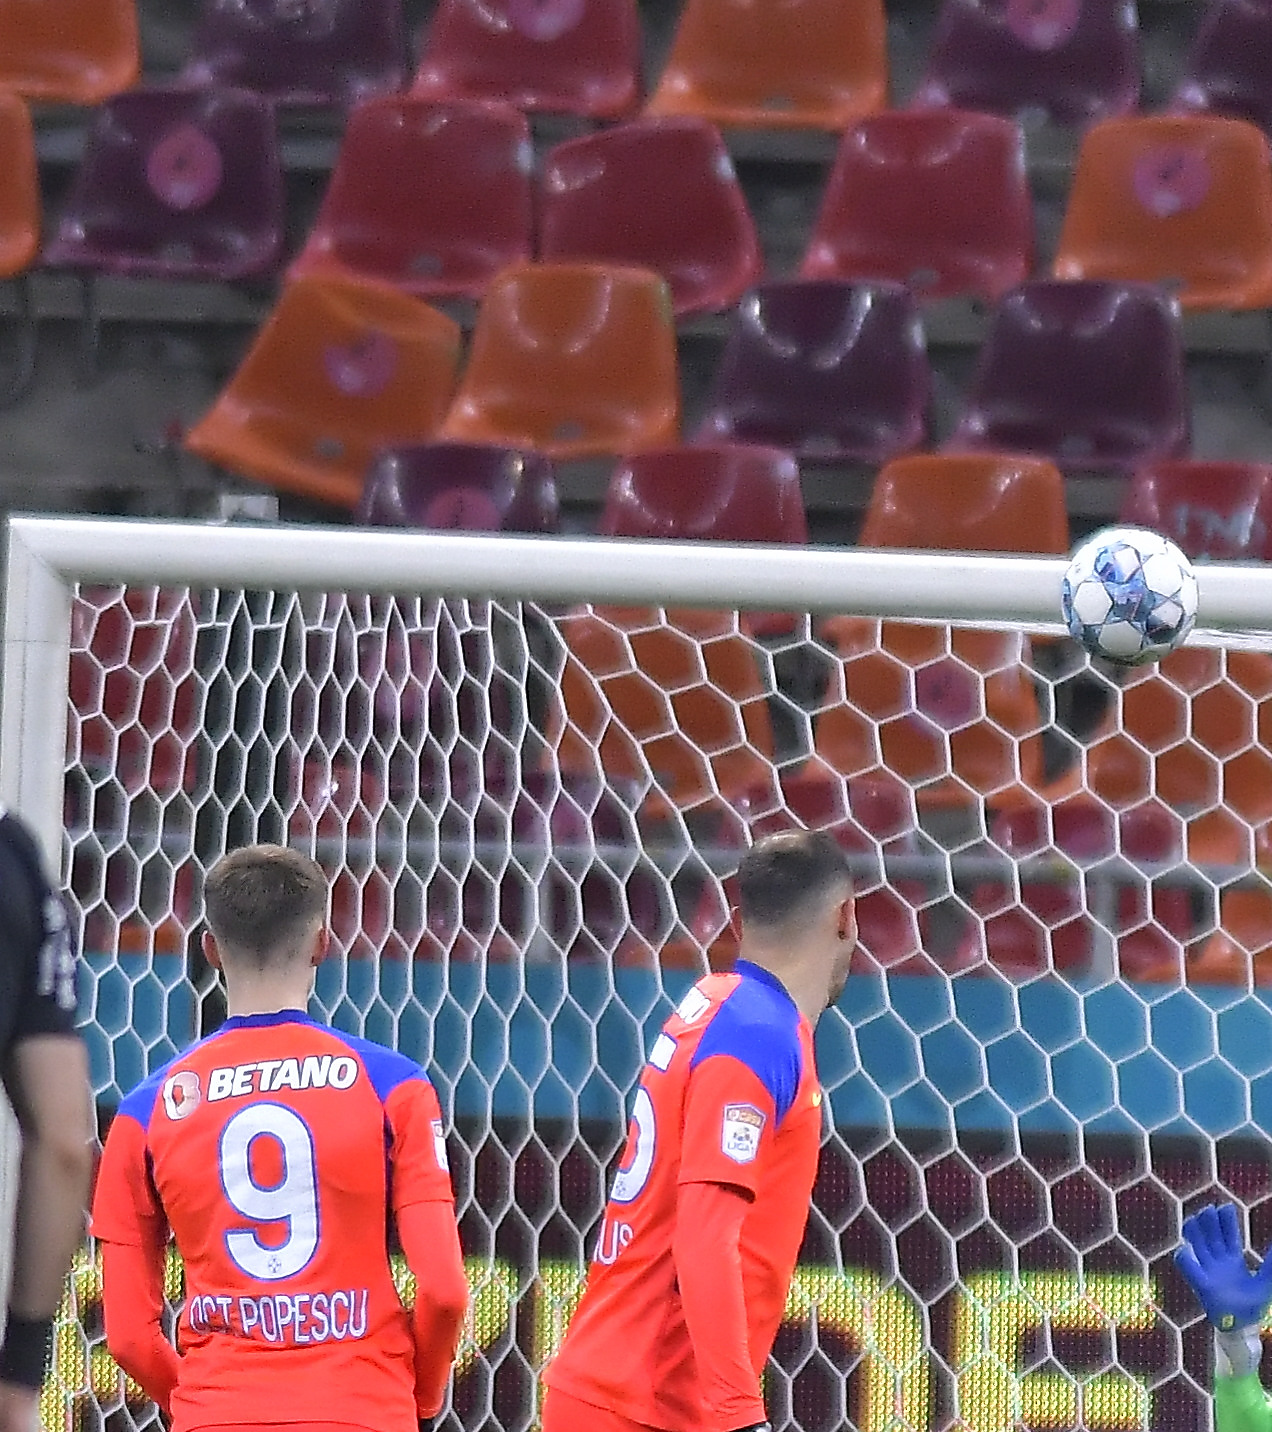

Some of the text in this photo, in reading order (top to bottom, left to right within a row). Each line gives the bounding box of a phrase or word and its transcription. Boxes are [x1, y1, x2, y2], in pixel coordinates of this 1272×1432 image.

[207, 1055, 357, 1102] BETANO
[219, 1103, 320, 1281] 9
[240, 1289, 367, 1342] POPESCU
